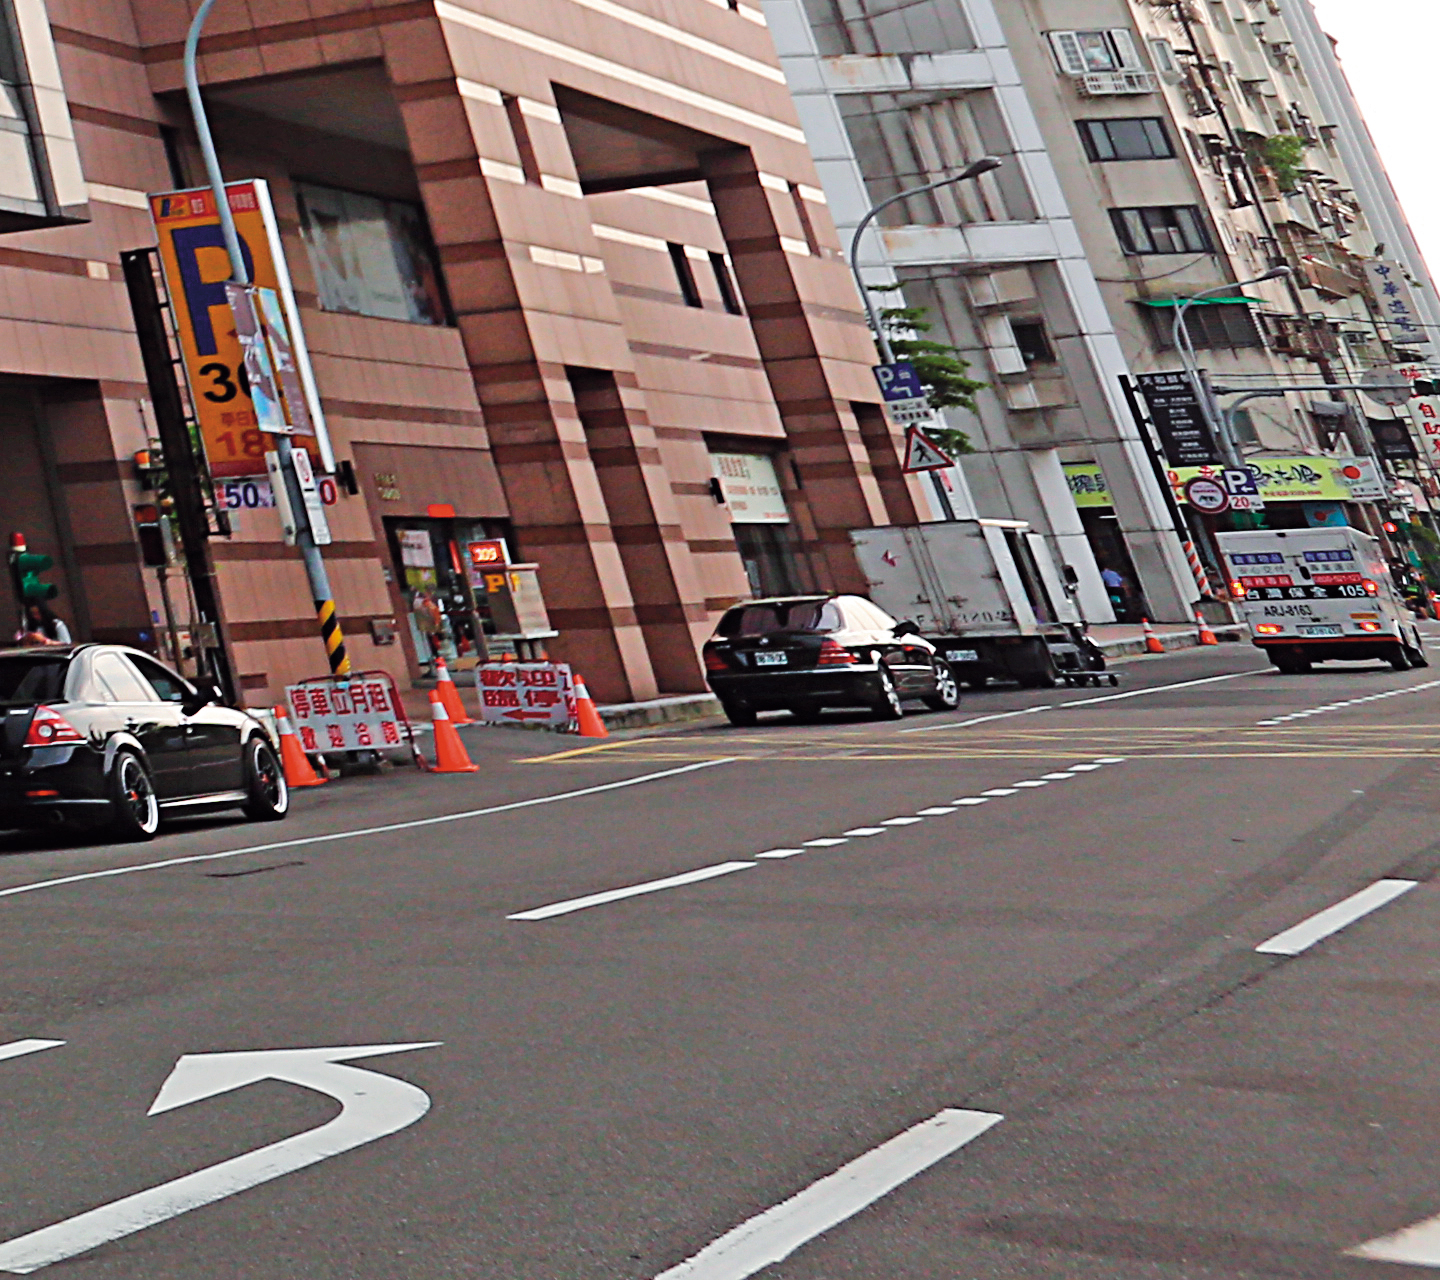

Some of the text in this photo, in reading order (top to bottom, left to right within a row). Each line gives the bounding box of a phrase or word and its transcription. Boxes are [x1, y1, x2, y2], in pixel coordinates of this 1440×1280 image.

[171, 224, 255, 356] P
[877, 367, 894, 390] P
[1226, 471, 1247, 493] P
[225, 483, 259, 509] 50
[1232, 497, 1250, 508] 20
[1246, 585, 1365, 599] 台灣保全 105
[480, 668, 557, 688] 歡迎
[290, 684, 390, 718] 停車位月租
[482, 689, 562, 707] 臨停
